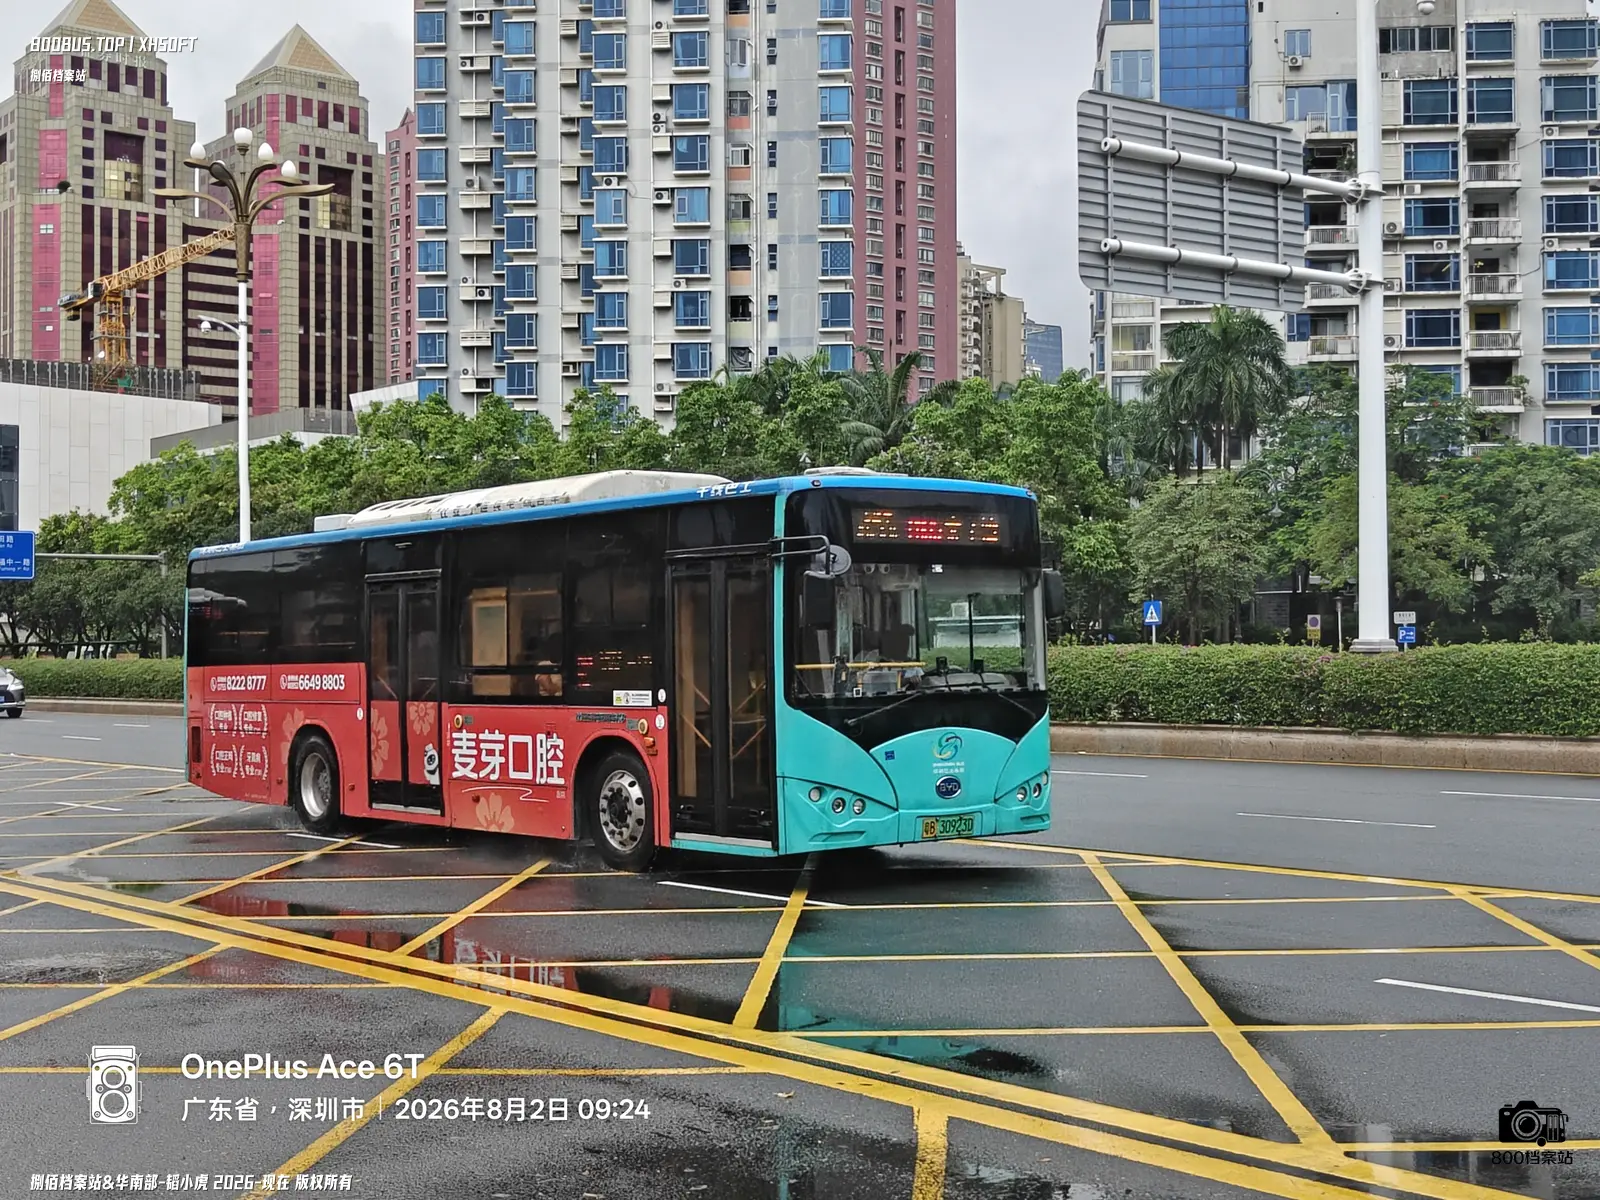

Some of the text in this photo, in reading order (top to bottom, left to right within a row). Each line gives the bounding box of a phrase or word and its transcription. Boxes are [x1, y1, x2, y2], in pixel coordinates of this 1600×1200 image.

[1399, 629, 1406, 640] P
[227, 676, 245, 690] 8222
[247, 675, 266, 690] 8777
[300, 675, 321, 690] 6649
[323, 674, 345, 690] 8803
[451, 728, 565, 785] 麦芽口腔
[939, 782, 959, 792] BYD
[939, 818, 973, 834] 30923D
